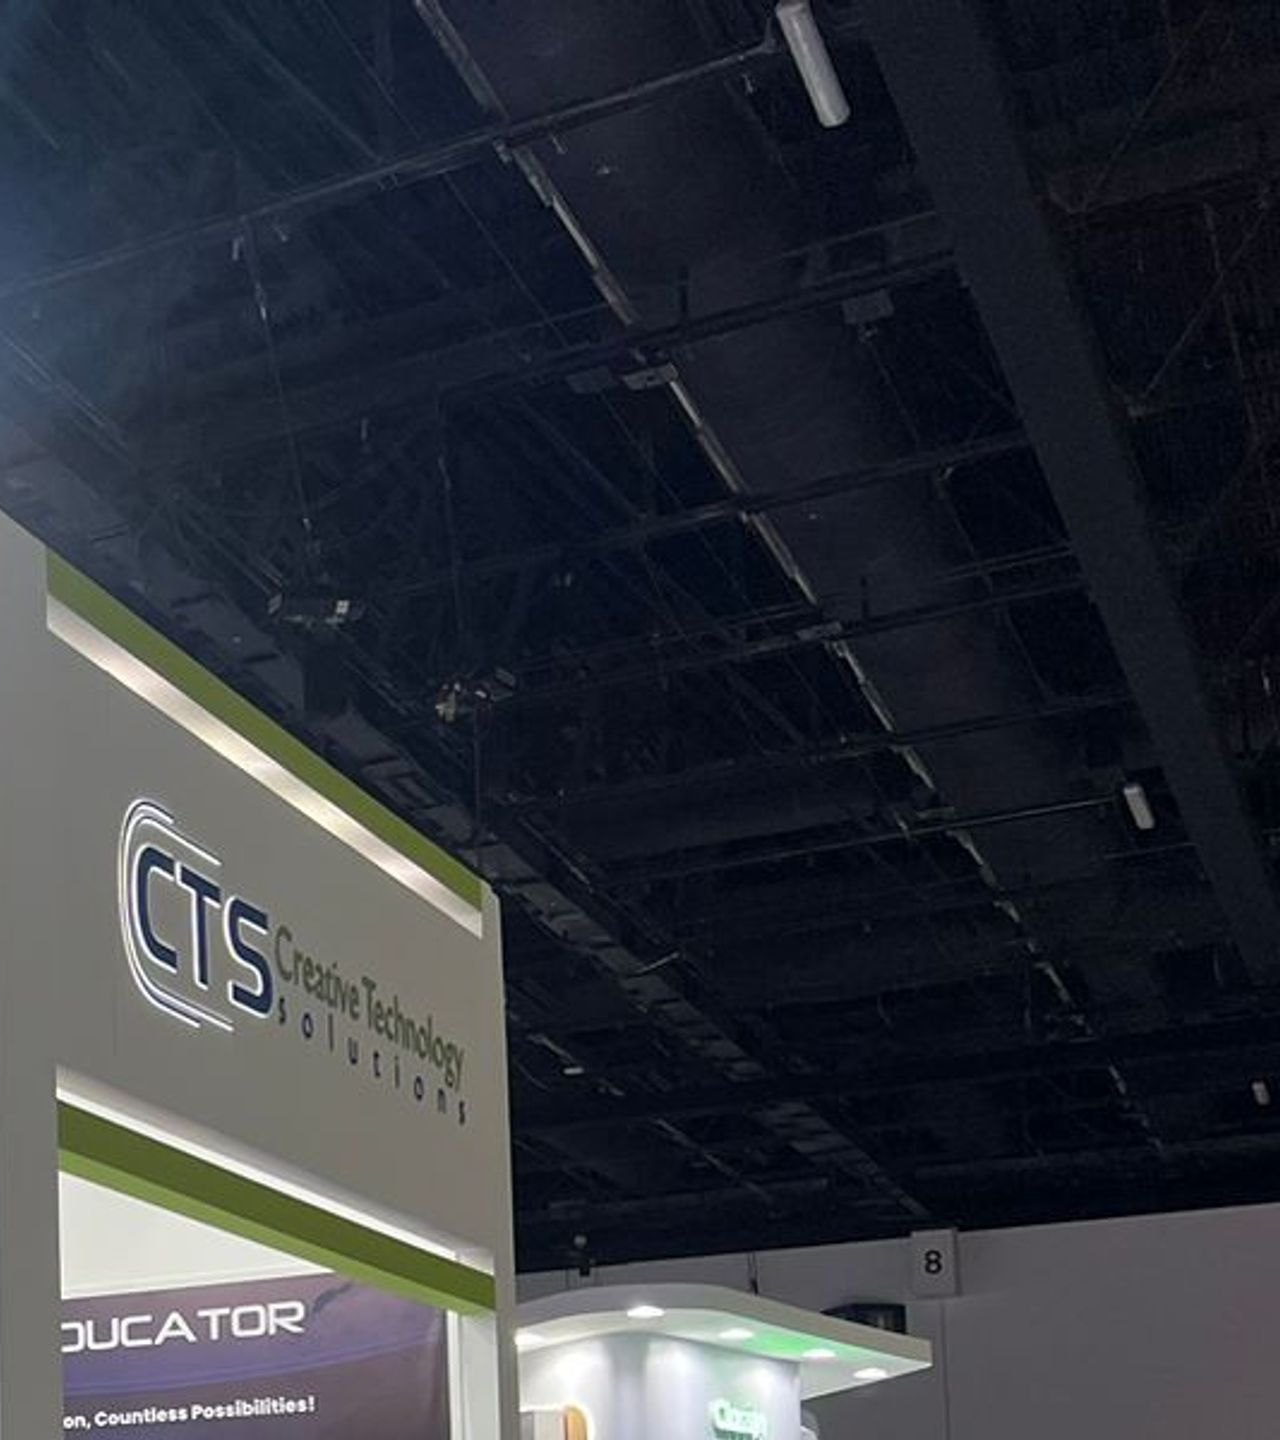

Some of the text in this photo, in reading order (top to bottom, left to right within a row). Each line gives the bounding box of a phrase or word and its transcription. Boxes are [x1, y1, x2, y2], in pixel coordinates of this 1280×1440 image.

[132, 844, 274, 1019] CTS
[274, 925, 465, 1092] Creative Technology
[278, 997, 466, 1126] solutions
[924, 1249, 943, 1275] 8
[61, 1300, 305, 1352] DUCATOR
[63, 1396, 315, 1430] on, Countless Possibilities!
